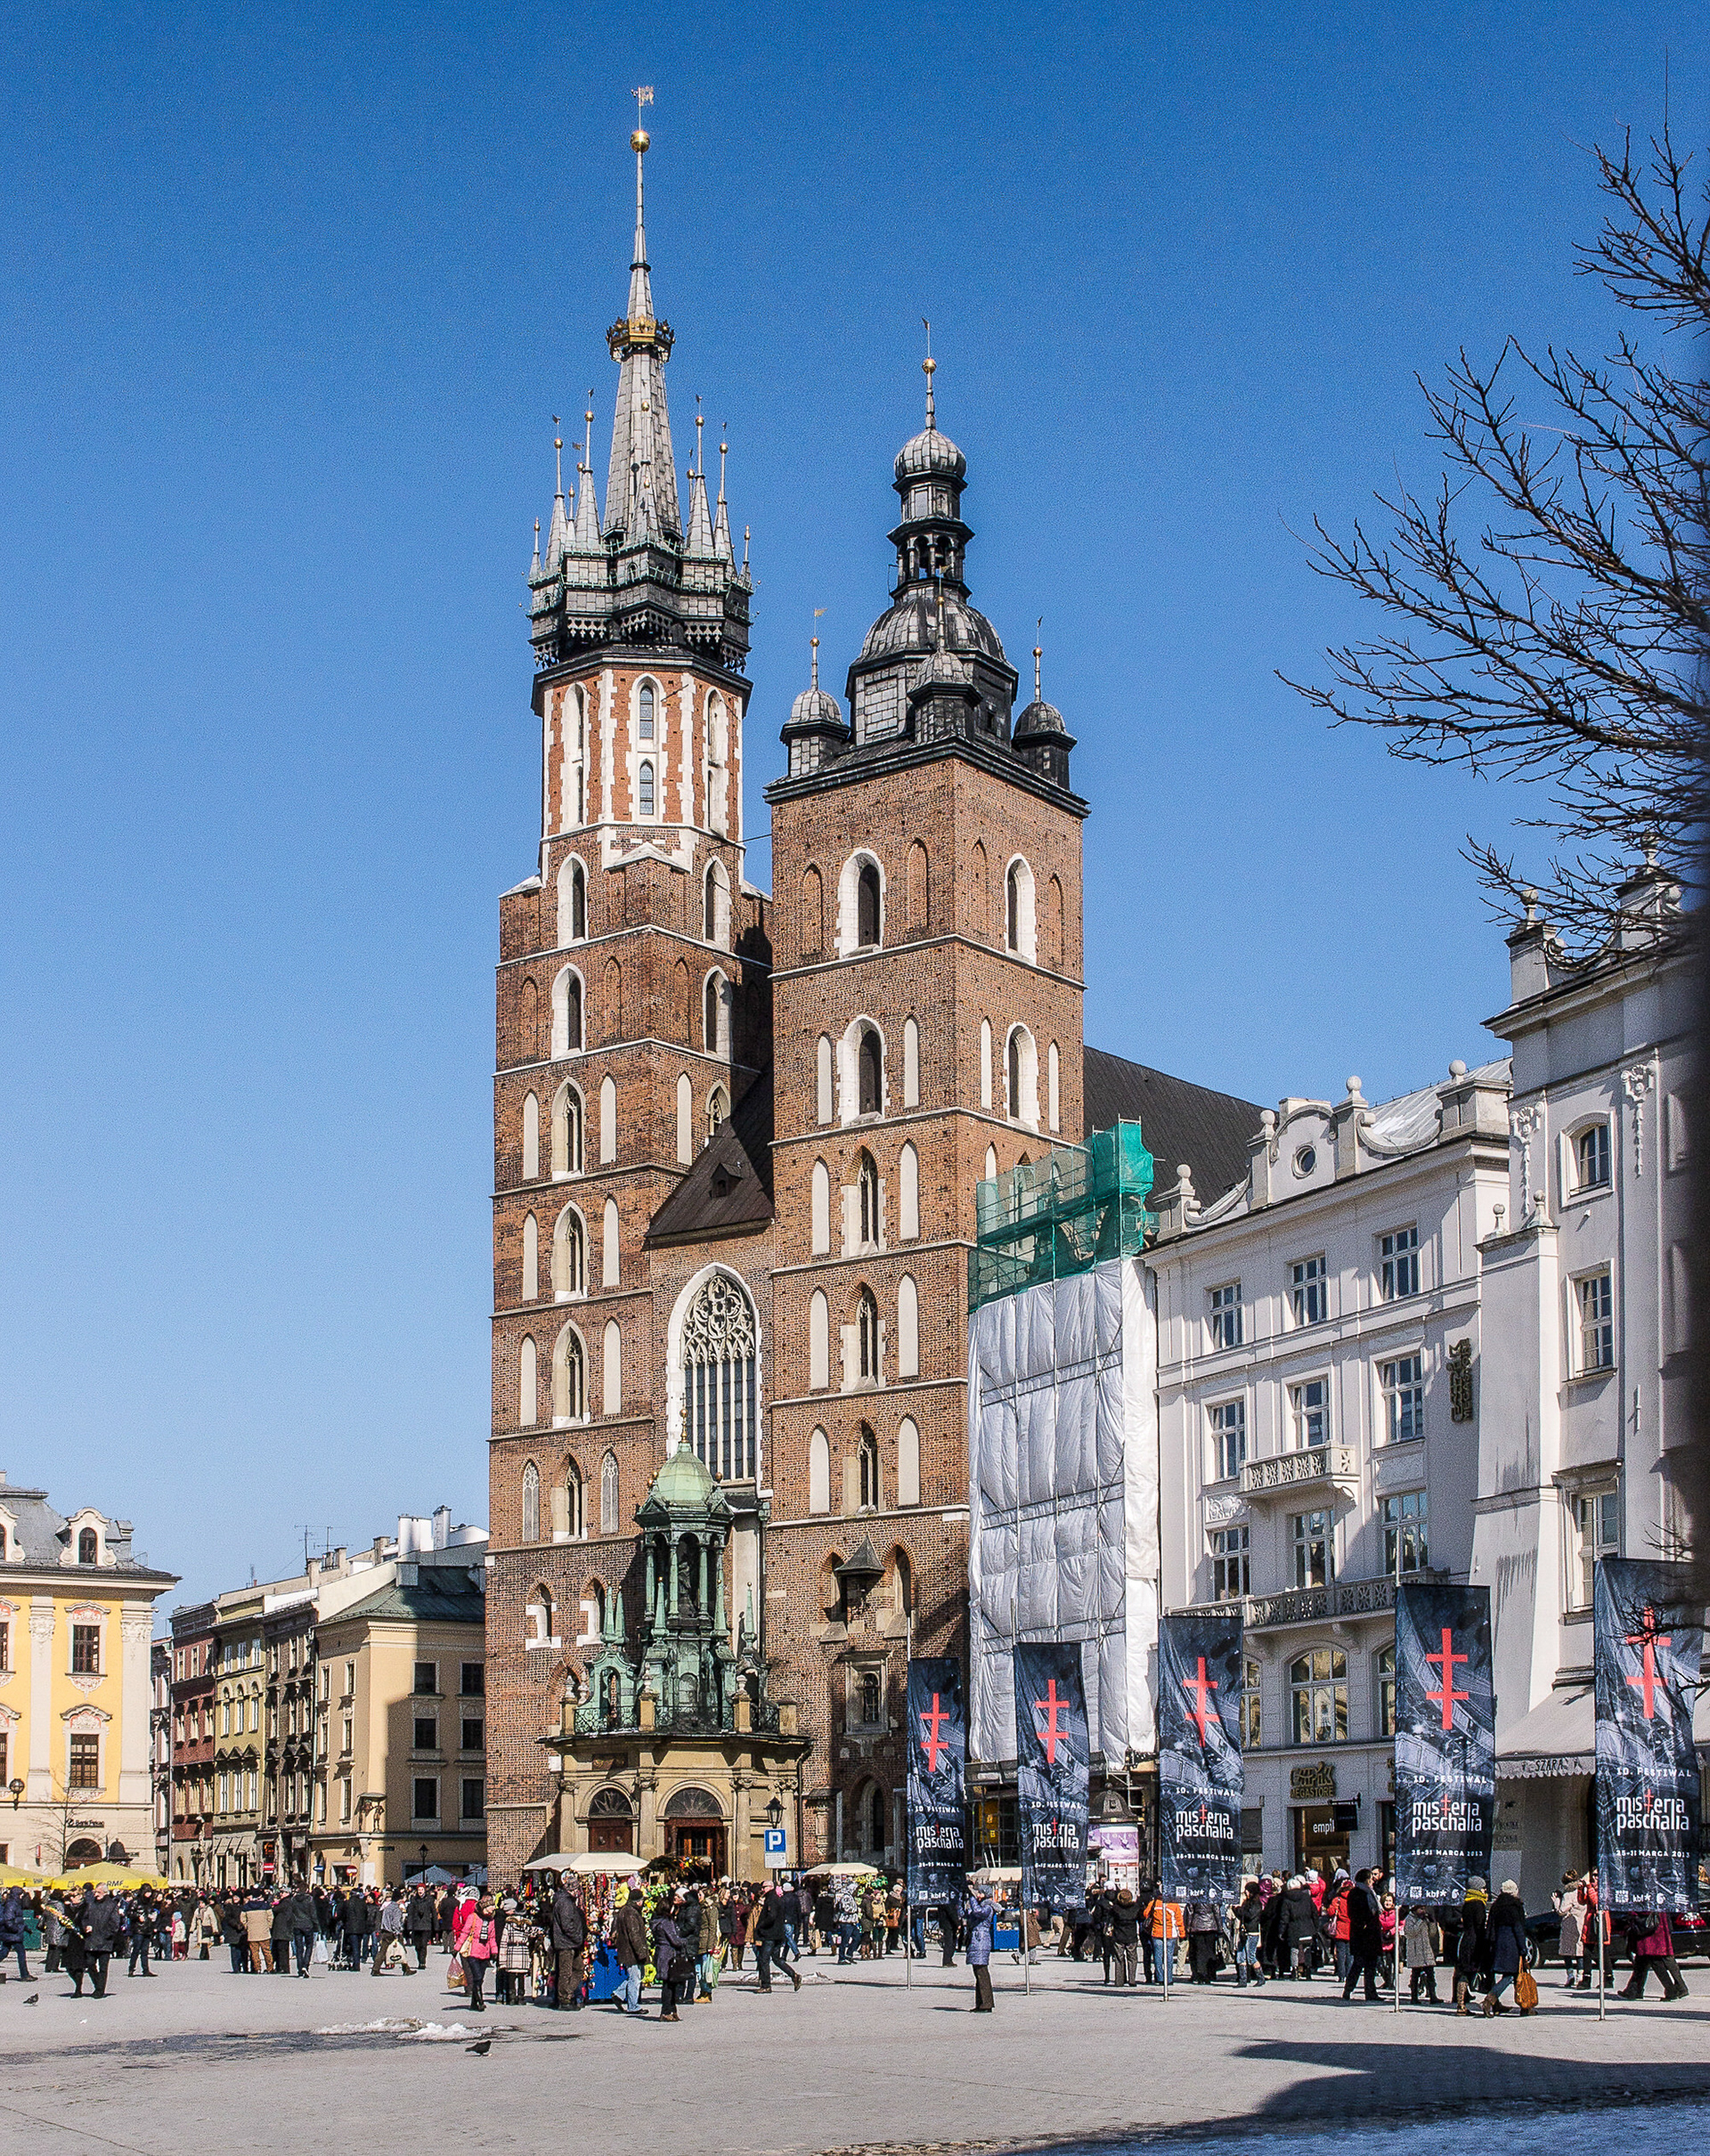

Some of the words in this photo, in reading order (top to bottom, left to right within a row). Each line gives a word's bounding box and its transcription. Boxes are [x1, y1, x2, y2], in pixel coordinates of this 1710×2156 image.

[1535, 1759, 1563, 1772] SZARA
[1616, 1767, 1633, 1776] 10.
[1637, 1767, 1692, 1778] FESTIWAL
[1413, 1775, 1429, 1783] 10.
[1434, 1775, 1487, 1784] FESTIWAL
[1176, 1786, 1190, 1794] 10.
[1193, 1786, 1235, 1796] FESTIWAL
[1290, 1786, 1334, 1798] MEGASTORE
[1412, 1794, 1479, 1817] misteria
[1616, 1788, 1685, 1814] misteria
[1176, 1804, 1230, 1825] misteria
[1616, 1810, 1690, 1836] paschalia
[1176, 1822, 1234, 1843] paschalia
[1412, 1813, 1482, 1837] paschalia
[769, 1831, 782, 1851] P
[916, 1835, 964, 1853] paschalia
[1638, 1849, 1669, 1857] MARCA
[1672, 1851, 1690, 1859] 2013
